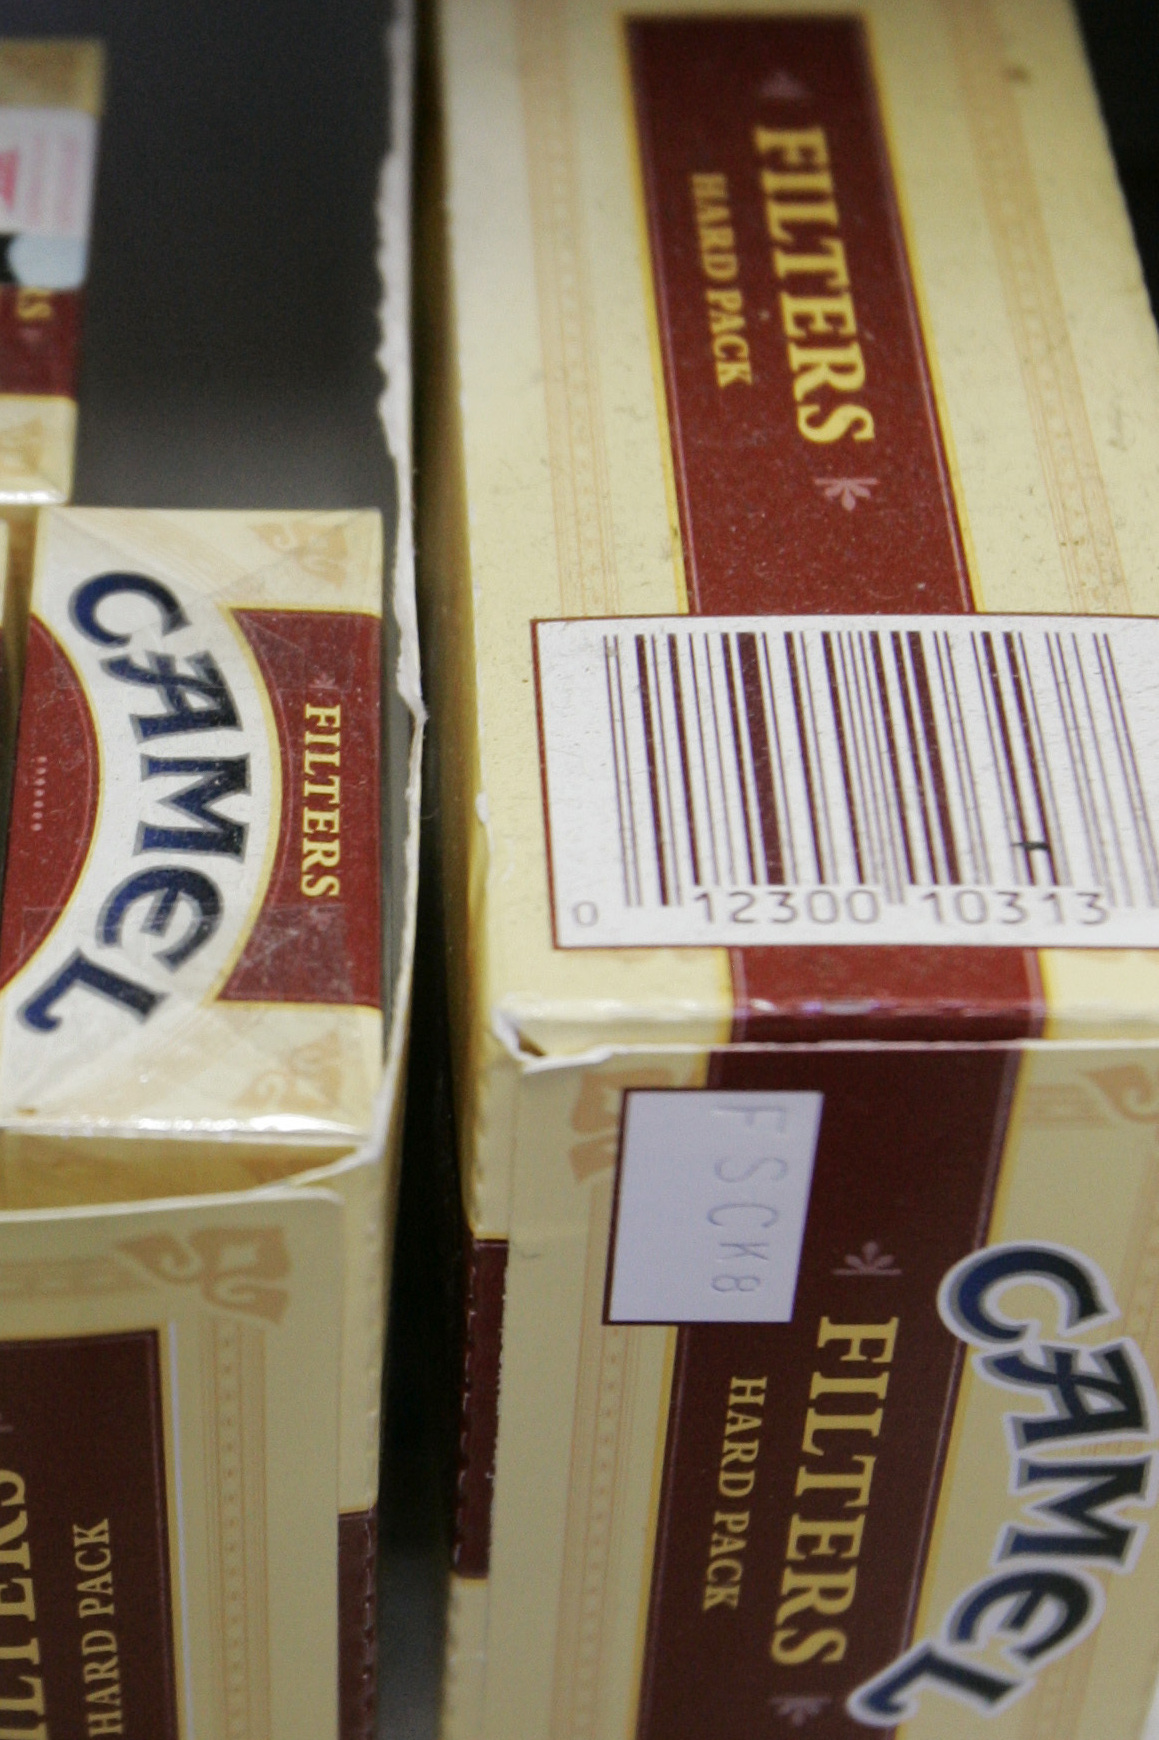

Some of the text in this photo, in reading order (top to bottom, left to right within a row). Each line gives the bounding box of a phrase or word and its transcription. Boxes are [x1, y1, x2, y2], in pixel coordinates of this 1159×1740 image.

[691, 172, 753, 389] HARD PACK
[754, 125, 876, 446] FILTERS
[15, 569, 252, 1035] CAMEL
[300, 703, 341, 899] FILTERS
[571, 888, 1111, 928] 0 12300 10313
[702, 1375, 769, 1612] HARD PACK
[770, 1315, 900, 1666] FILTERS
[850, 1241, 1156, 1723] CAMEL
[71, 1516, 124, 1739] HARD PACK
